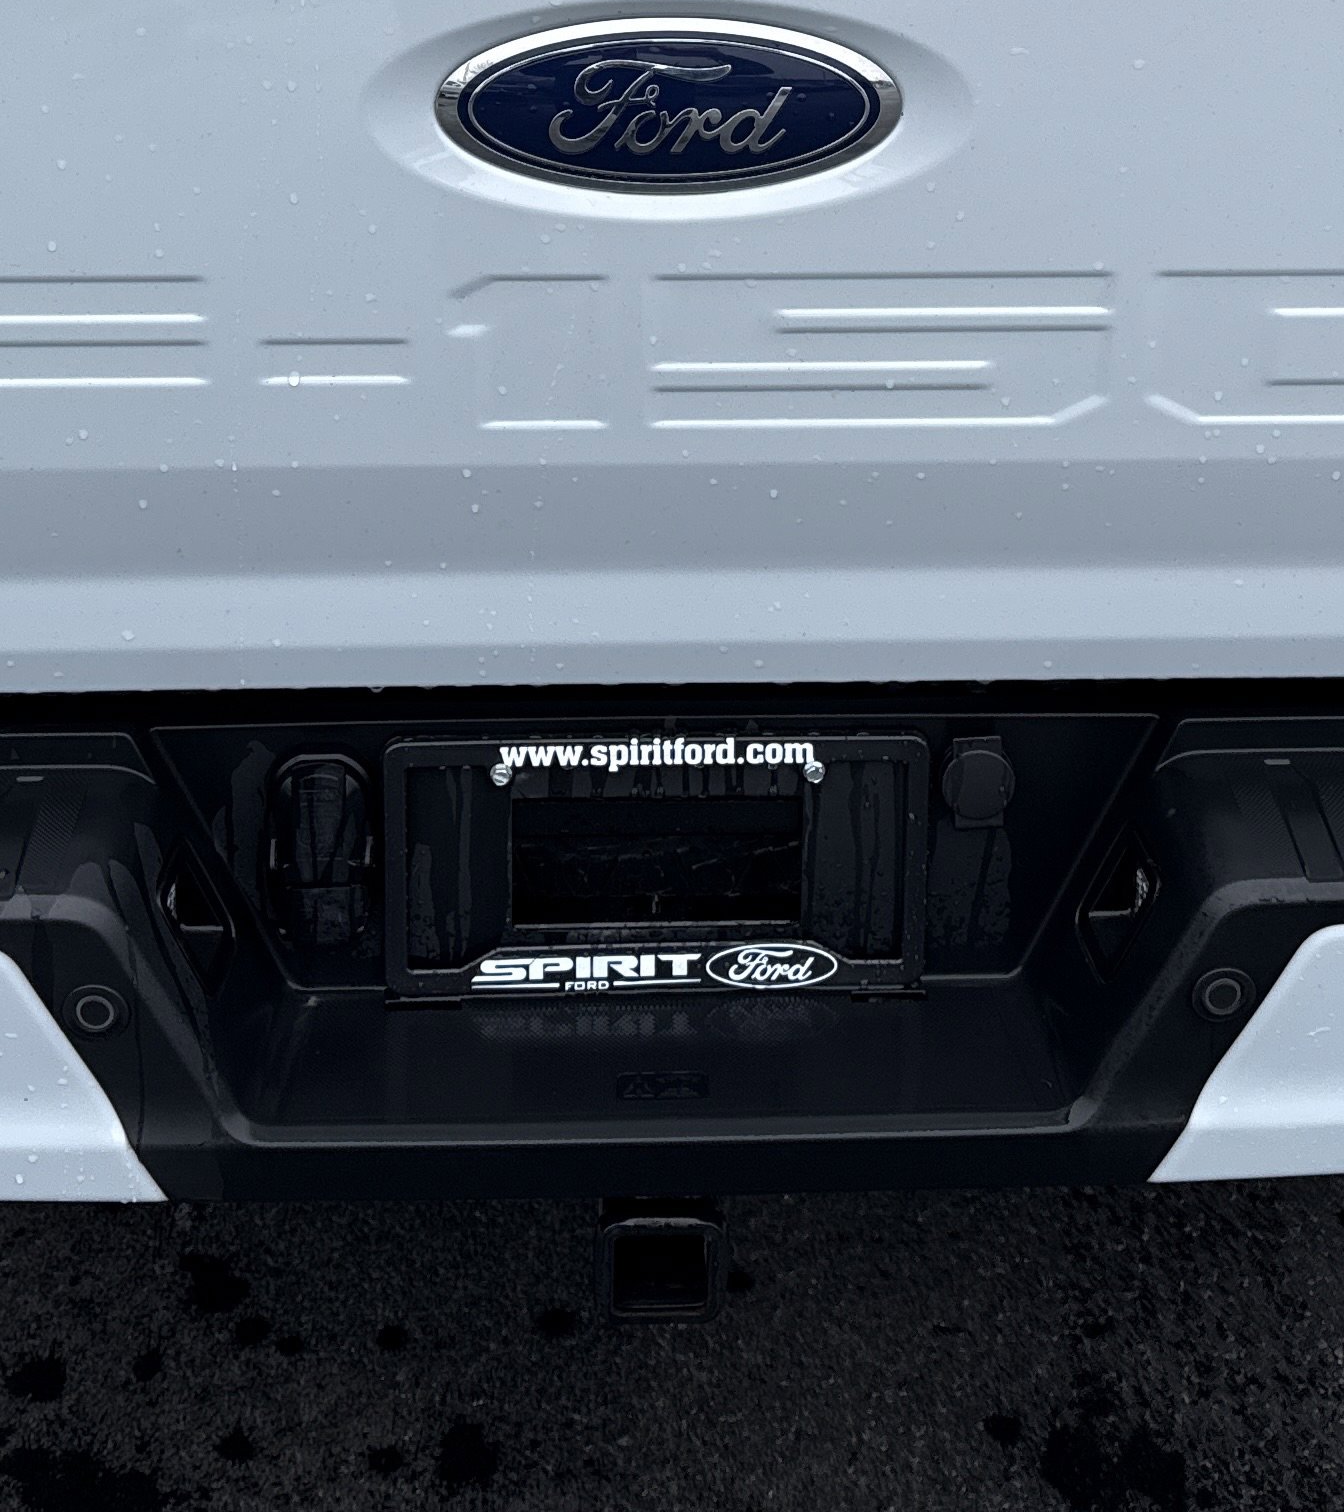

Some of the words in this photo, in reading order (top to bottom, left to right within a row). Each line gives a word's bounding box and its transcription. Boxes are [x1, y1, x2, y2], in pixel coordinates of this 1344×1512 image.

[549, 58, 792, 154] Ford
[498, 737, 816, 772] www.spiritford.com
[471, 952, 702, 982] SPIRIT
[728, 949, 813, 981] Ford
[564, 979, 610, 991] FORD
